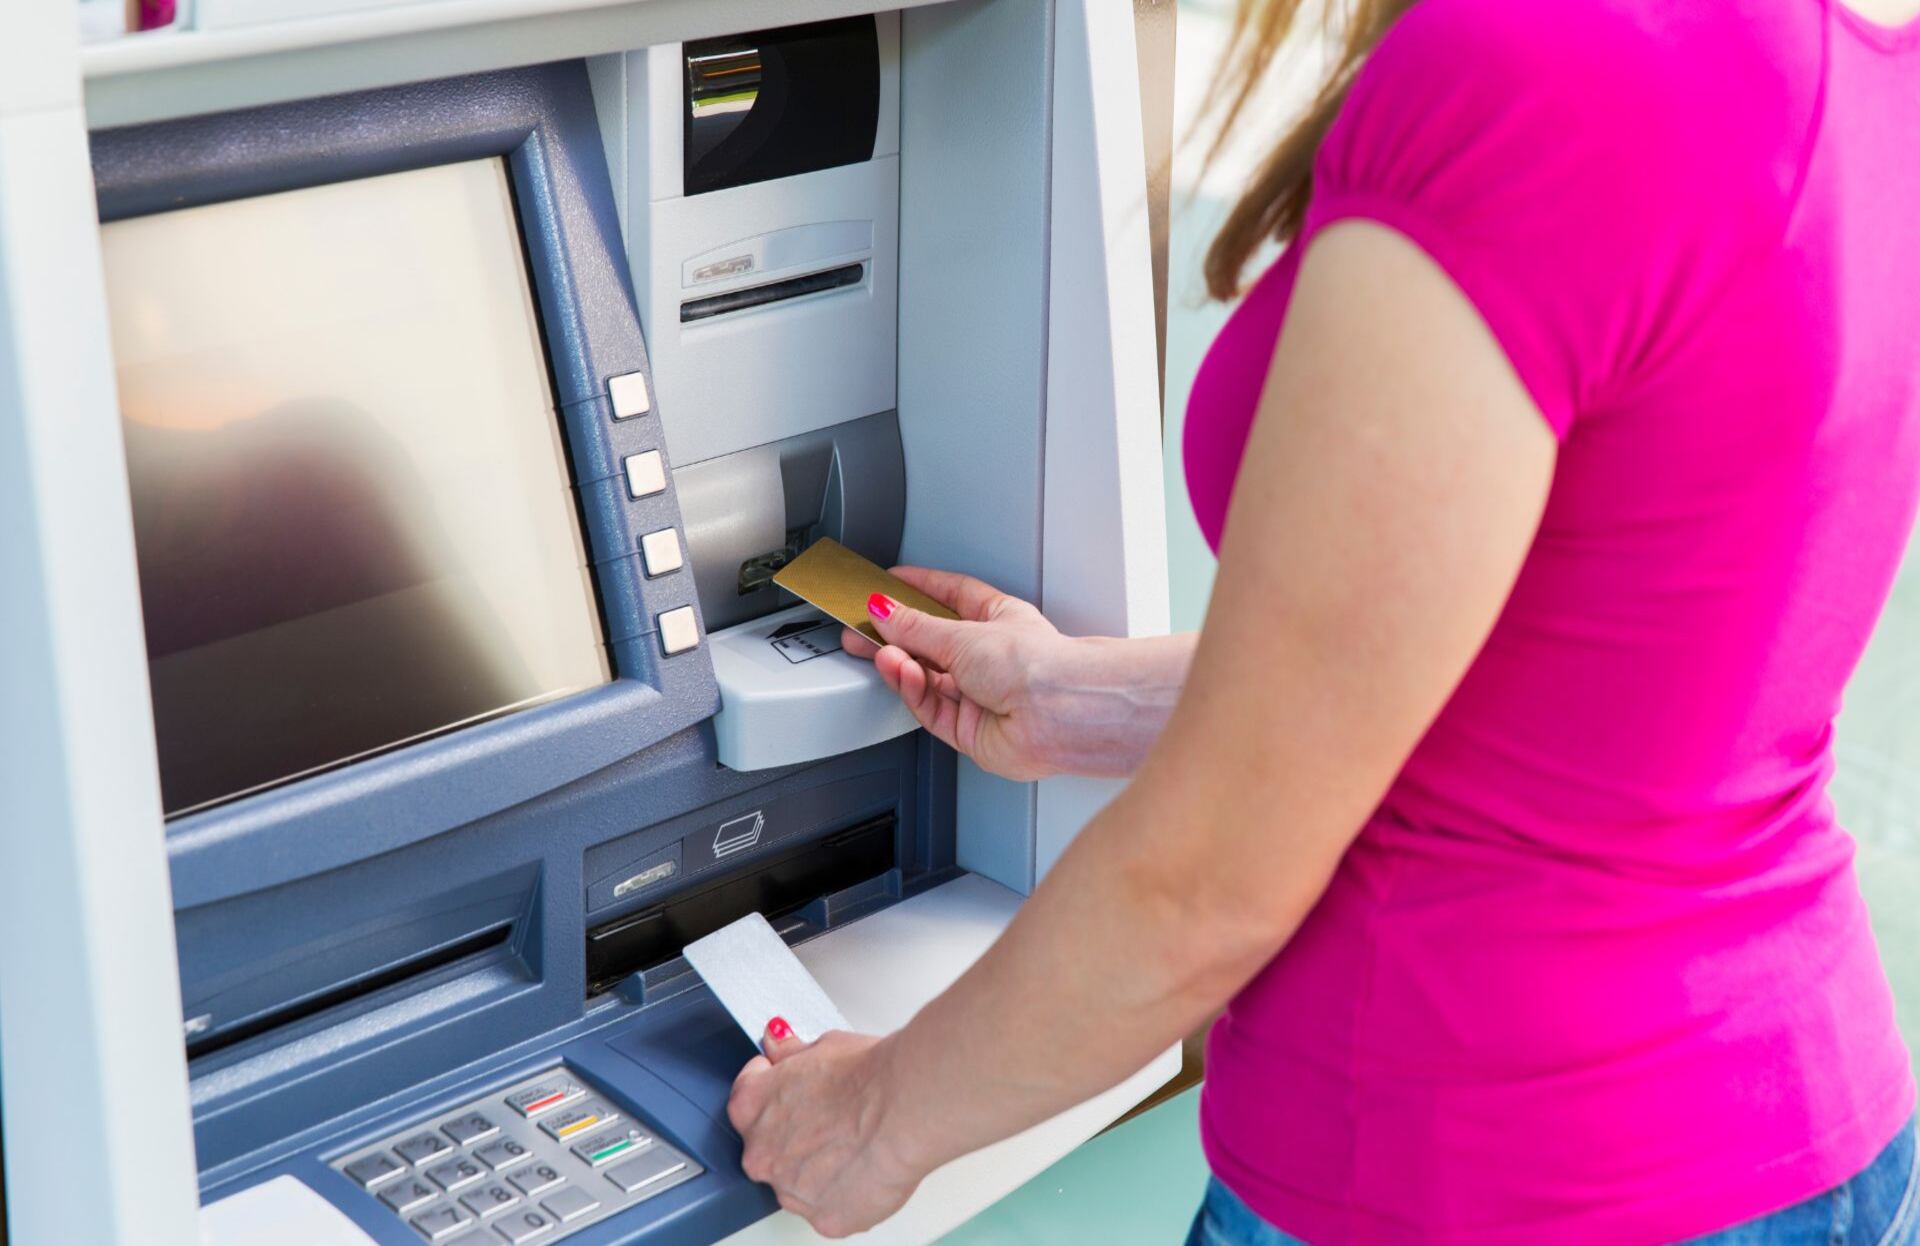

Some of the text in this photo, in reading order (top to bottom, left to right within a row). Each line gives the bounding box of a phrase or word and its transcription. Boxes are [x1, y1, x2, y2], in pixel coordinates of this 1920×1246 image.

[471, 1117, 492, 1132] 3
[424, 1137, 447, 1153] 2
[504, 1140, 525, 1156] 6
[380, 1157, 399, 1170] 1
[457, 1160, 478, 1176] 5
[537, 1165, 557, 1181] 9
[413, 1182, 433, 1197] 4
[489, 1186, 511, 1202] 8
[441, 1207, 461, 1223] 7
